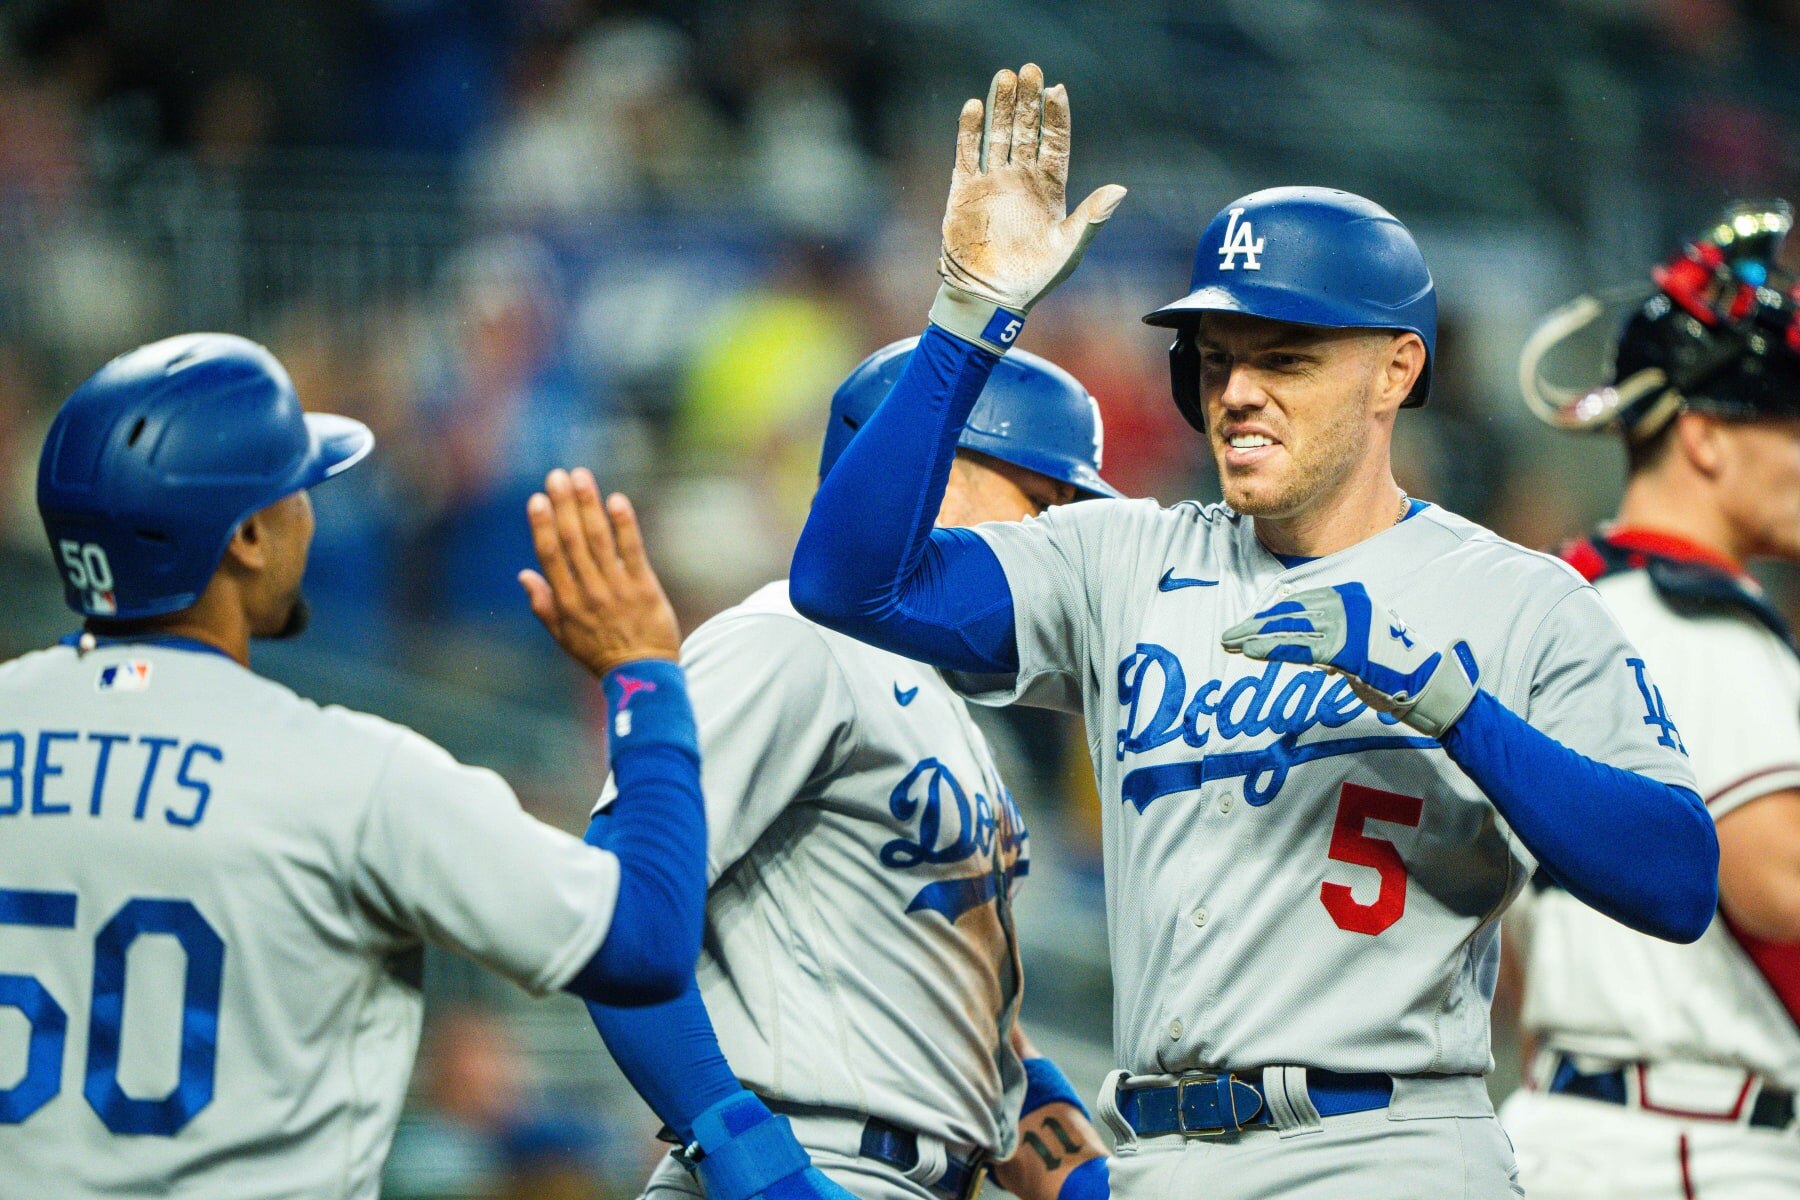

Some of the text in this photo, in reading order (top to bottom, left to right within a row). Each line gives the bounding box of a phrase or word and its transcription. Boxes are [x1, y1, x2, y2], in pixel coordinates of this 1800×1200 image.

[1218, 207, 1265, 270] LA
[1000, 319, 1022, 343] 5
[60, 538, 114, 592] 50
[1116, 642, 1401, 808] Dodge
[0, 730, 224, 828] BETTS
[1319, 781, 1424, 937] 5
